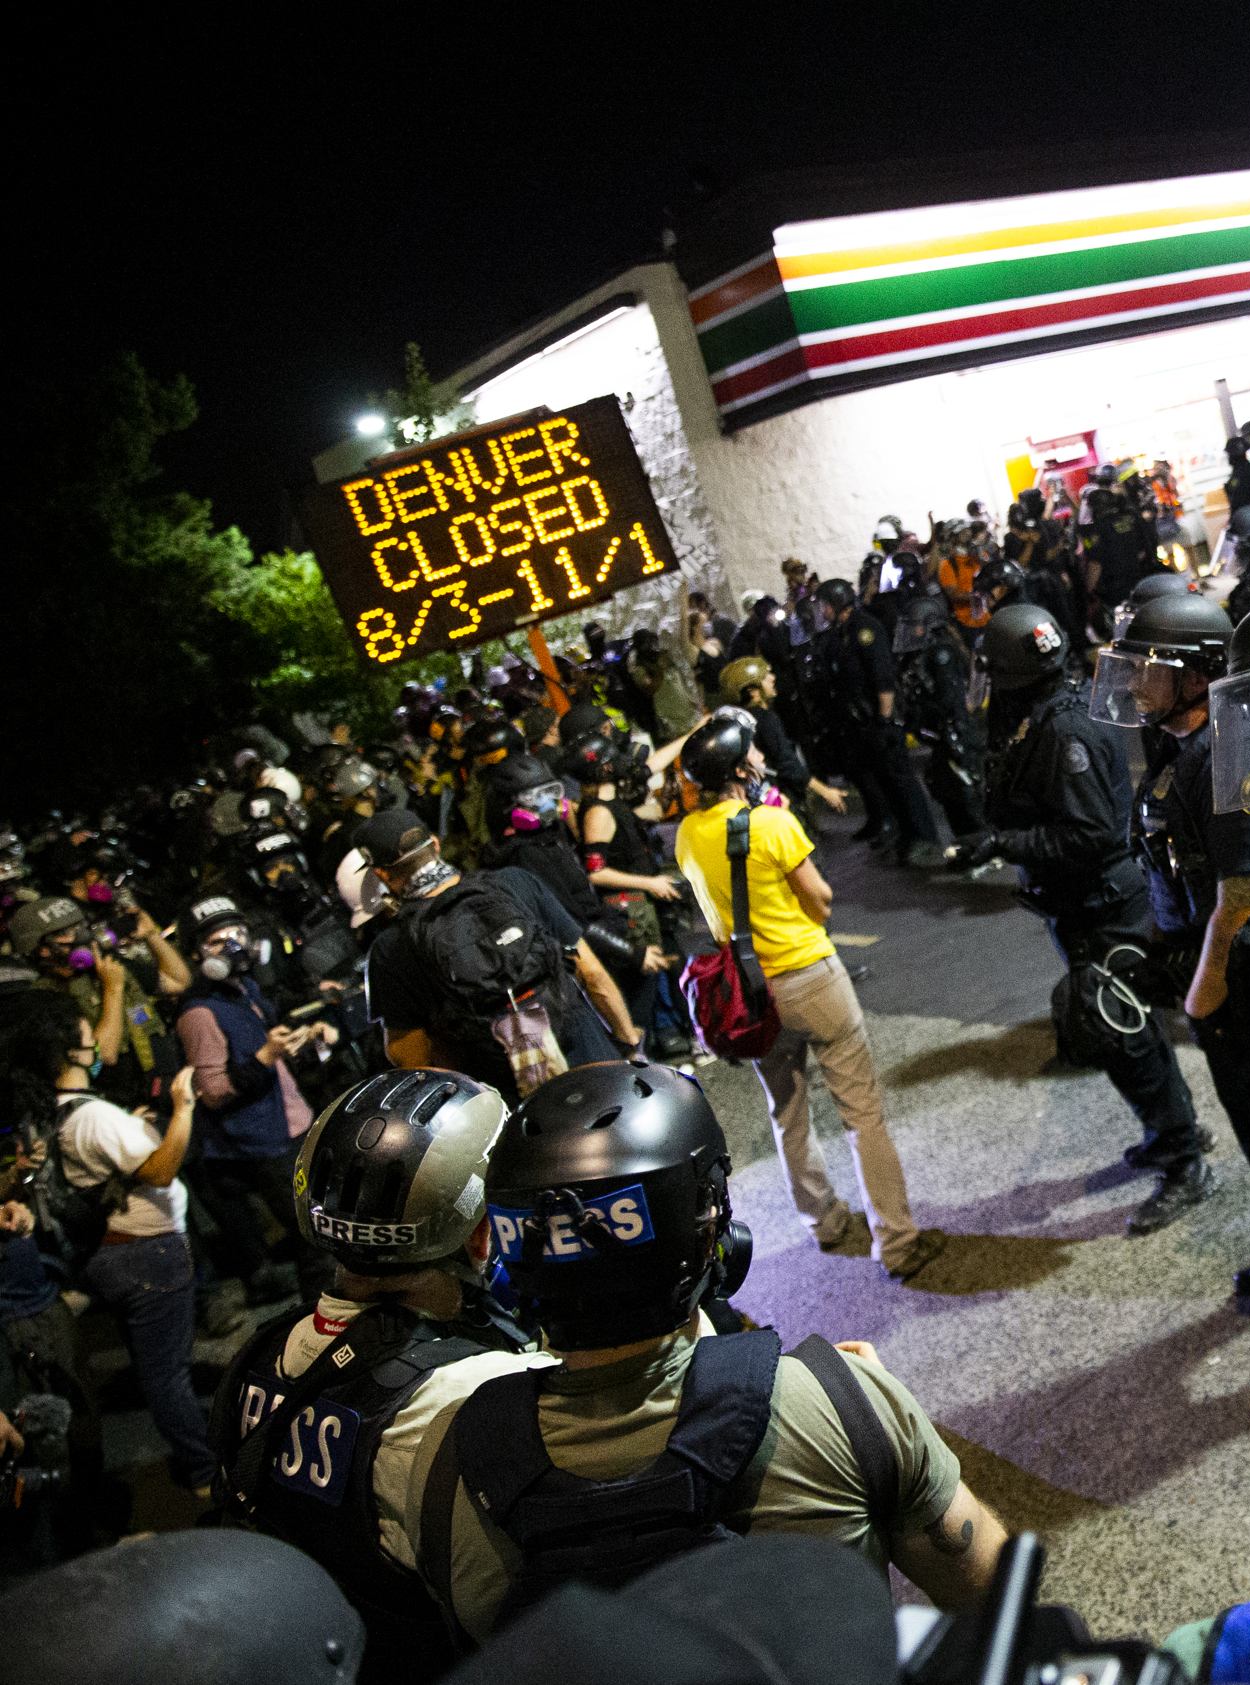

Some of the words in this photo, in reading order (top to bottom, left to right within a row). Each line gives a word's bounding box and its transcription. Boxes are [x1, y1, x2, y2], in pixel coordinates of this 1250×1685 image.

[341, 416, 591, 537] DENVER
[370, 475, 610, 593] CLOSED
[355, 522, 665, 663] 8/3-11/1
[316, 1213, 416, 1246] PRESS
